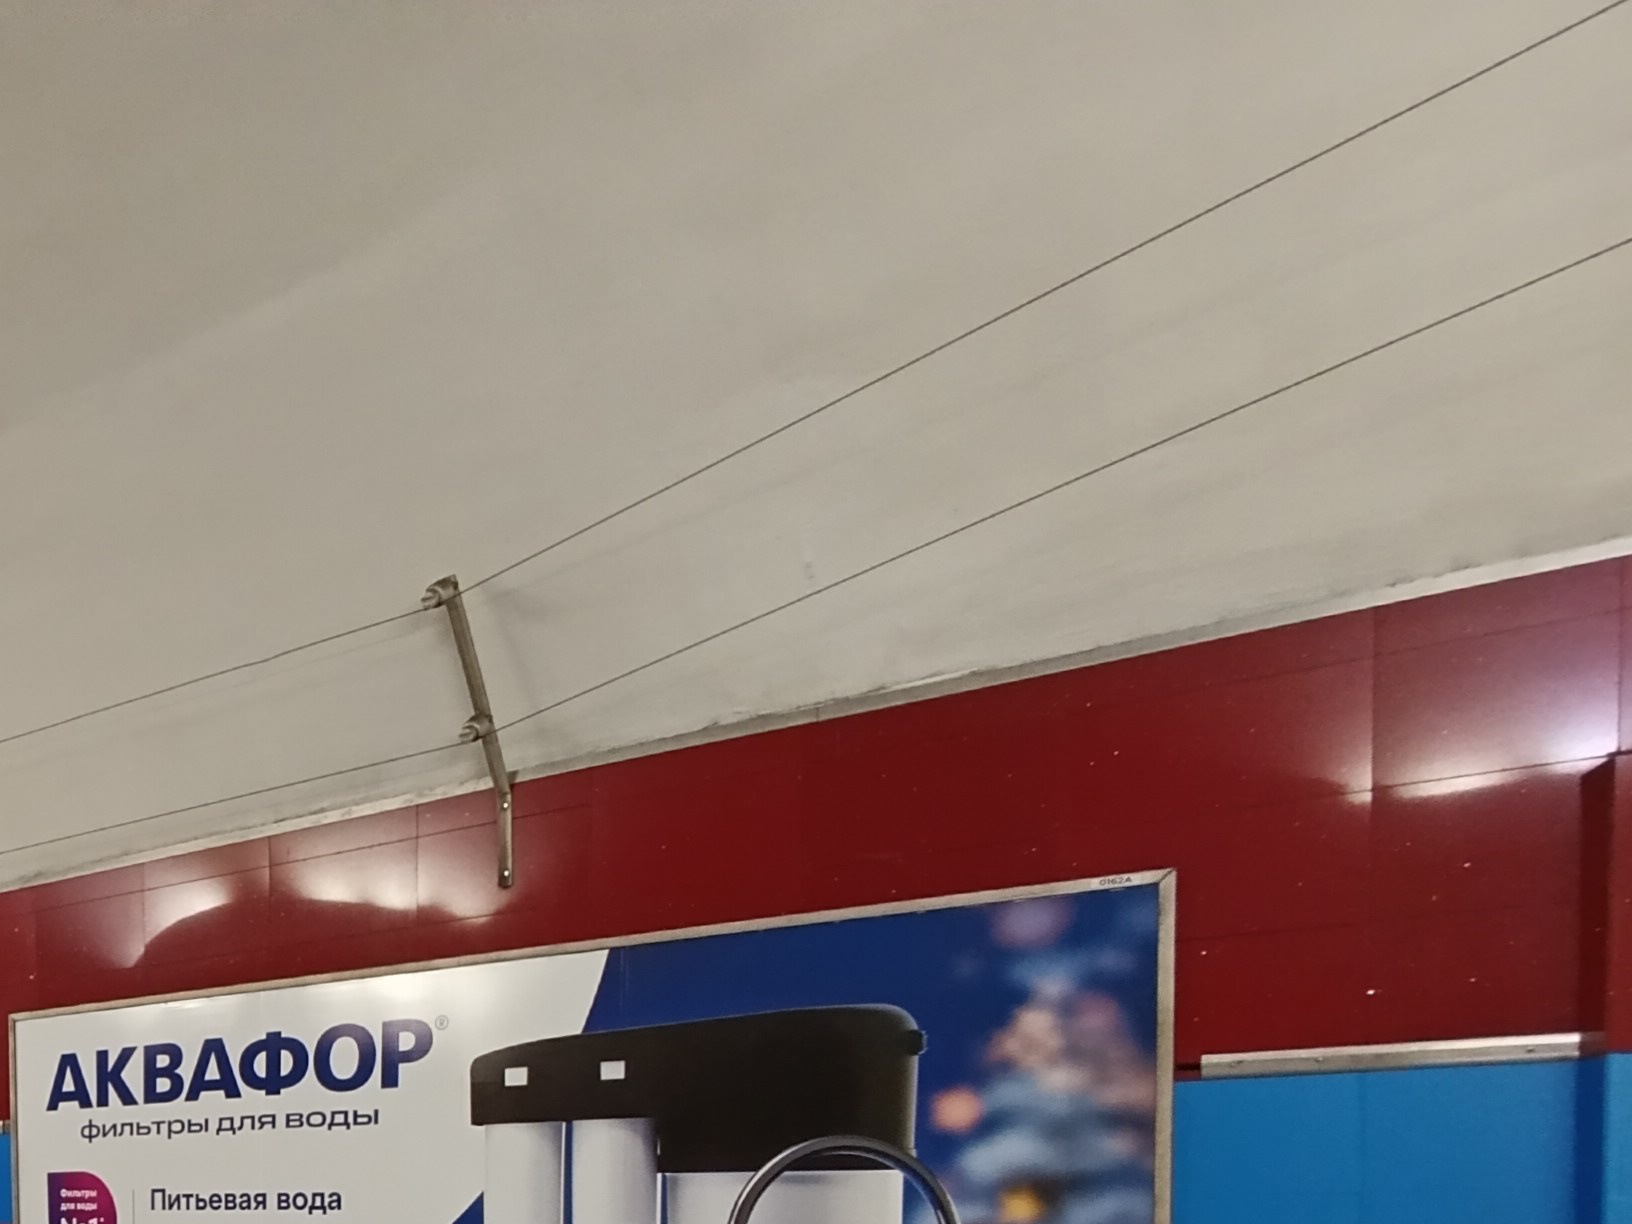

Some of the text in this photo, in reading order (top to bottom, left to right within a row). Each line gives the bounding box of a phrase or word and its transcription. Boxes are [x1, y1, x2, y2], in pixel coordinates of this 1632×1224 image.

[46, 1018, 434, 1111] АКВАФОР
[80, 1109, 379, 1143] фильтры для воды
[60, 1189, 97, 1199] Фильтры
[149, 1188, 342, 1216] Питьевая вода
